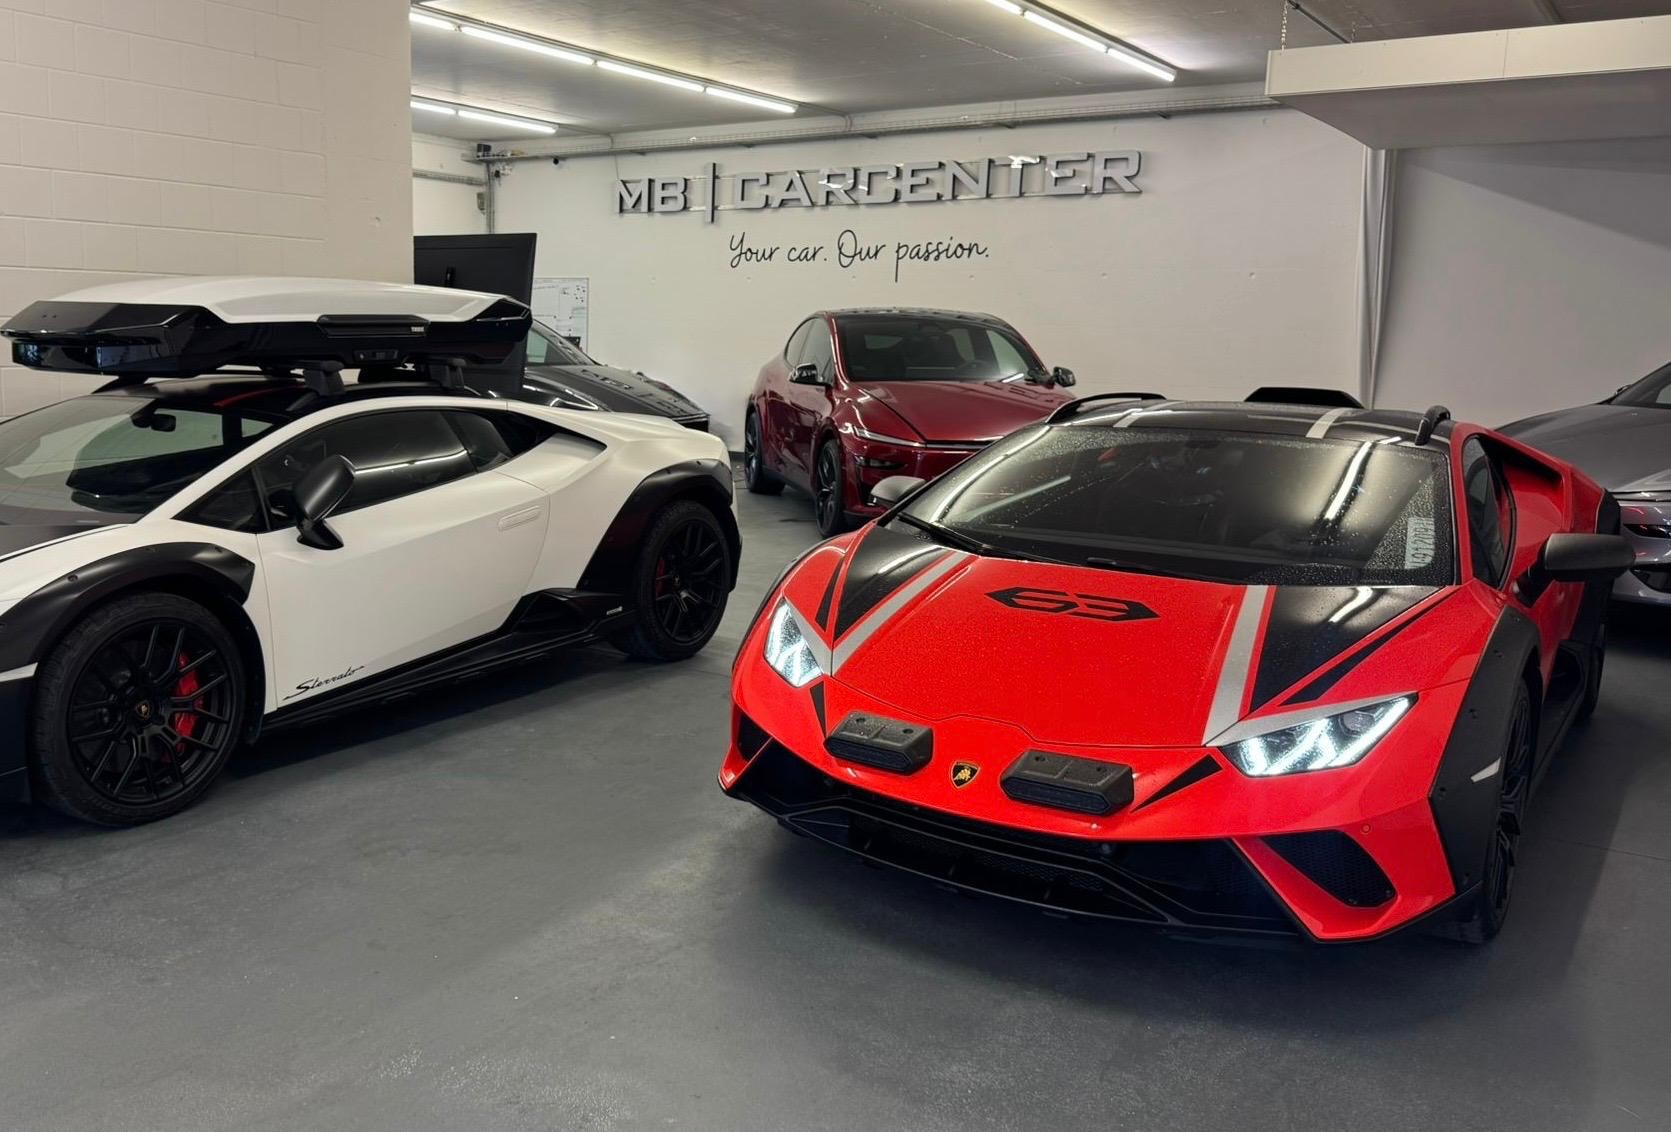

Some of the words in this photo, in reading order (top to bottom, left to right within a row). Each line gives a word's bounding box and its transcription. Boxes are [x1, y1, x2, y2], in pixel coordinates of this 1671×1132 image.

[616, 177, 688, 214] MB
[734, 151, 1143, 210] CARCENTER
[729, 231, 780, 269] Your
[787, 245, 828, 263] car.
[837, 229, 887, 268] Our
[894, 236, 990, 283] passion.
[984, 586, 1160, 622] 63
[282, 665, 365, 701] Sterrato
